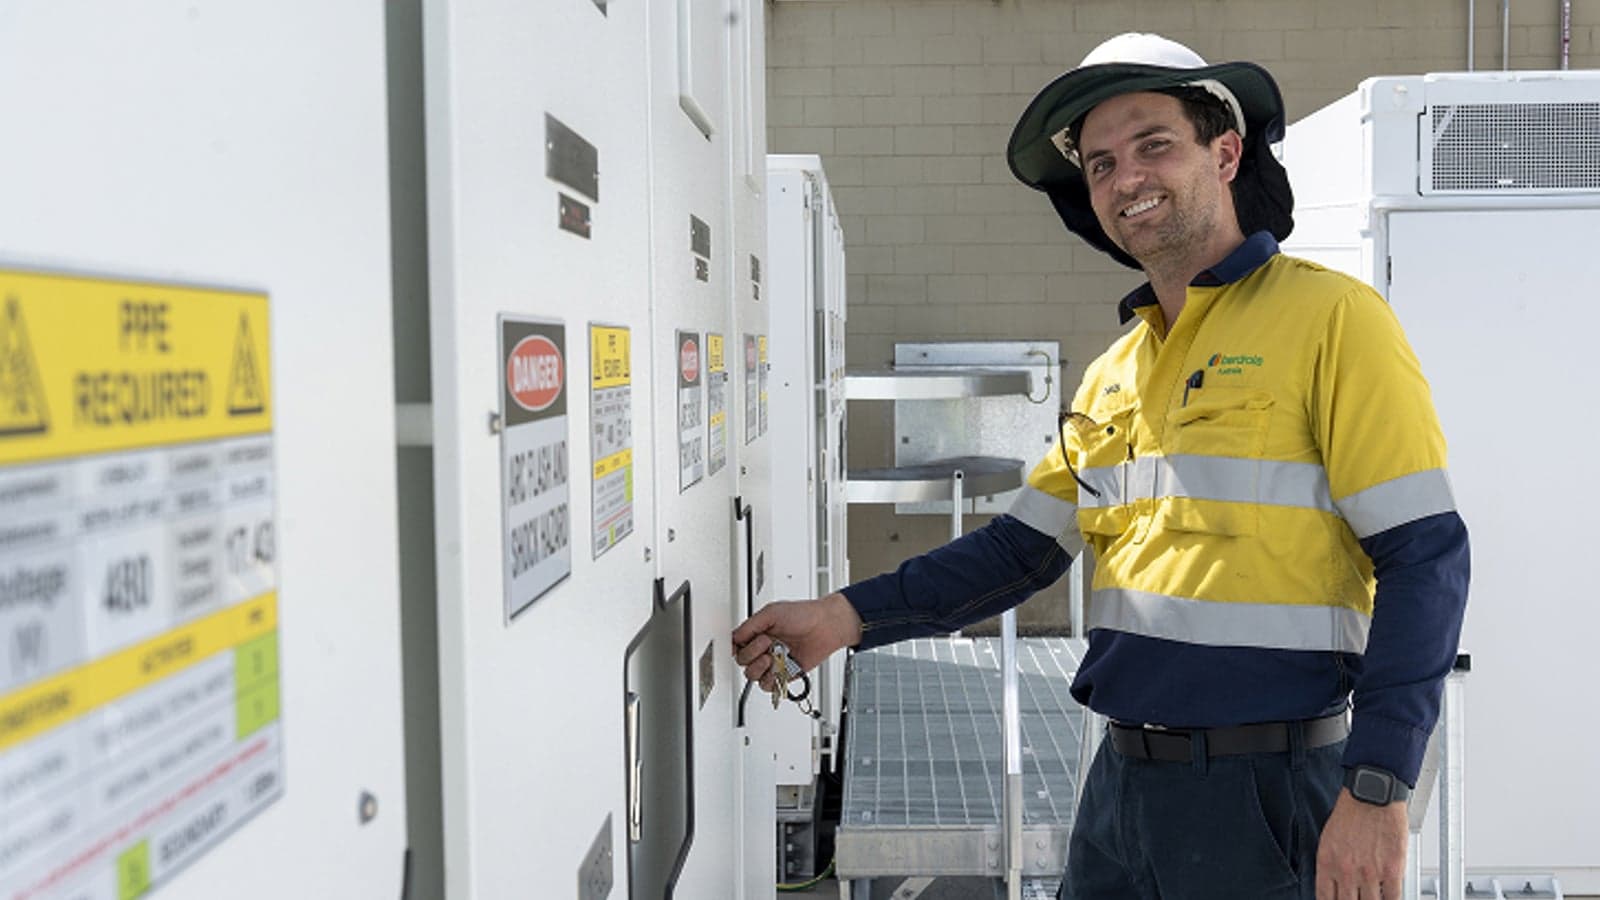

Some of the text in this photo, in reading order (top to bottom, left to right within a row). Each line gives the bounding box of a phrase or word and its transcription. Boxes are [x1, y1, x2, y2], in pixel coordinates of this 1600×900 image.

[119, 301, 172, 353] PPE
[73, 370, 213, 429] REQUIRED
[513, 354, 560, 393] DANGER
[540, 502, 568, 557] HAZARD
